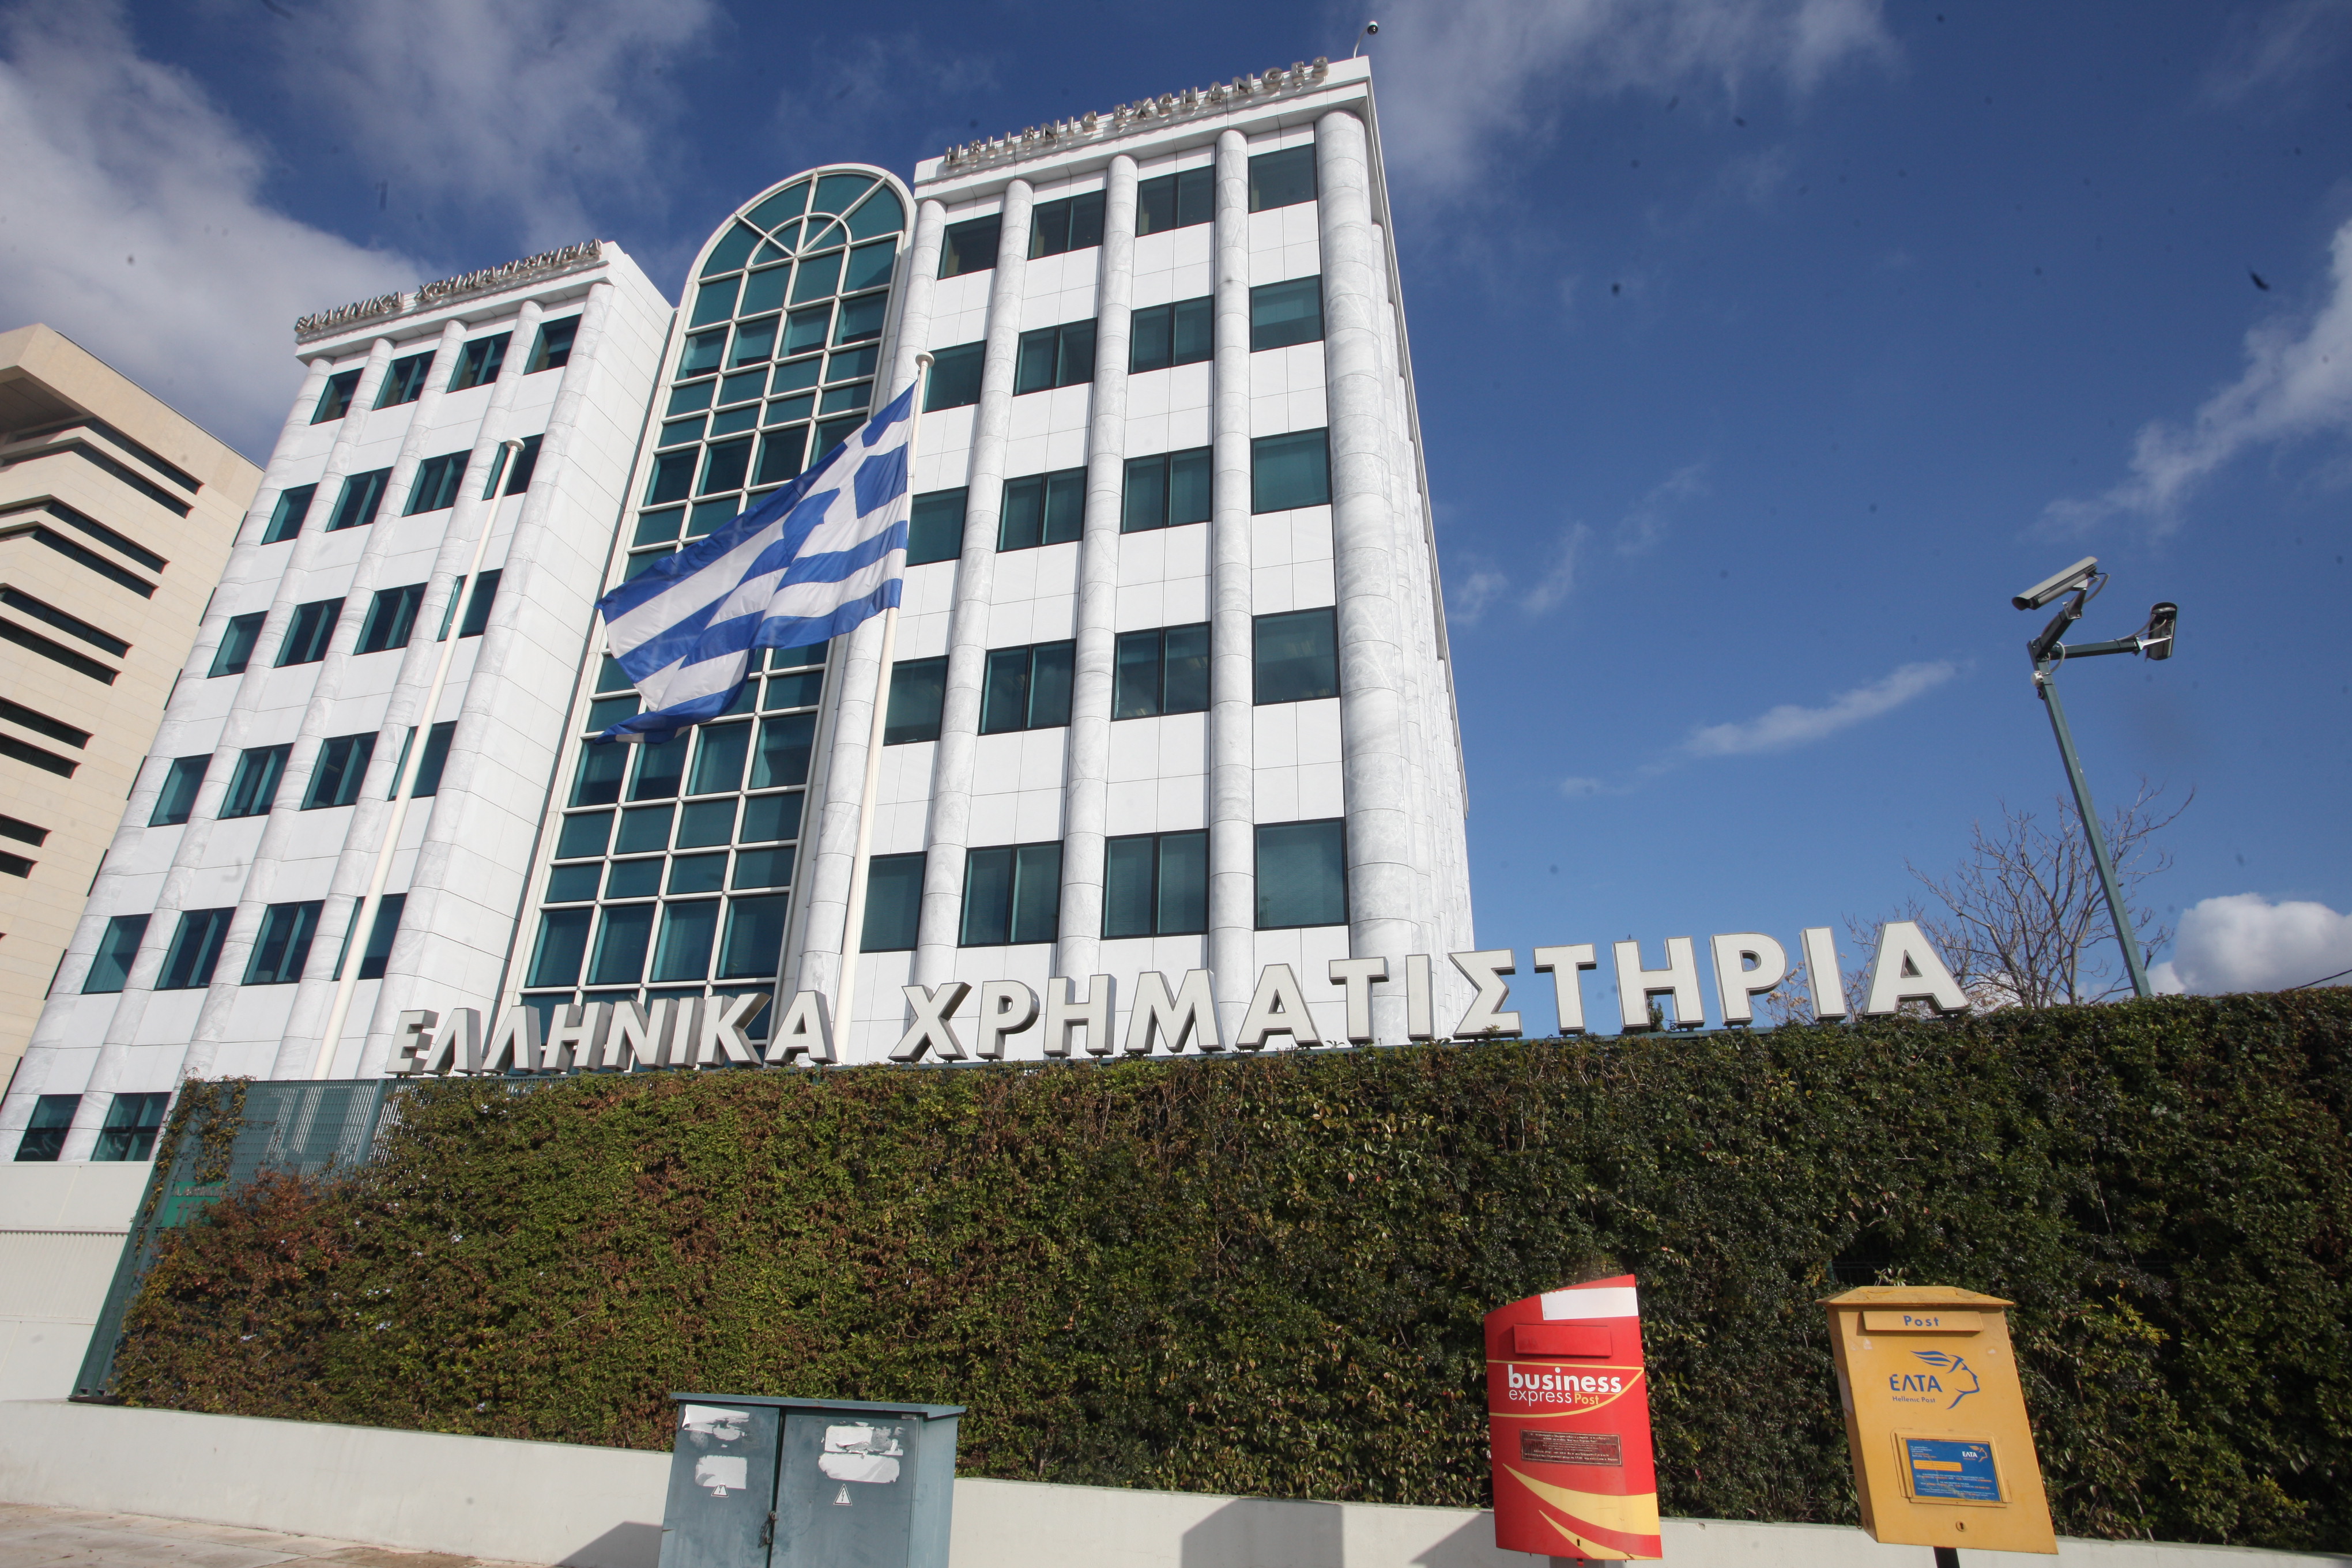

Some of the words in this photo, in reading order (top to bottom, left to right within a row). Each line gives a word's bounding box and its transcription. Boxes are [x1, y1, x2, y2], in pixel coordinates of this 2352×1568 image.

[944, 111, 1098, 167] HELLENIC
[1113, 56, 1329, 126] EXCHANGES
[385, 990, 838, 1075] ΕΛΛΗΝΙΚΑ
[888, 921, 1972, 1062] ΧΡΗΜΑΤΙΣΤΗΡΙΑ
[1904, 1315, 1939, 1326] Post
[1507, 1364, 1622, 1393] business
[1889, 1374, 1943, 1393] ΕΛΤΑ
[1509, 1389, 1572, 1407] express
[1574, 1393, 1599, 1405] Post
